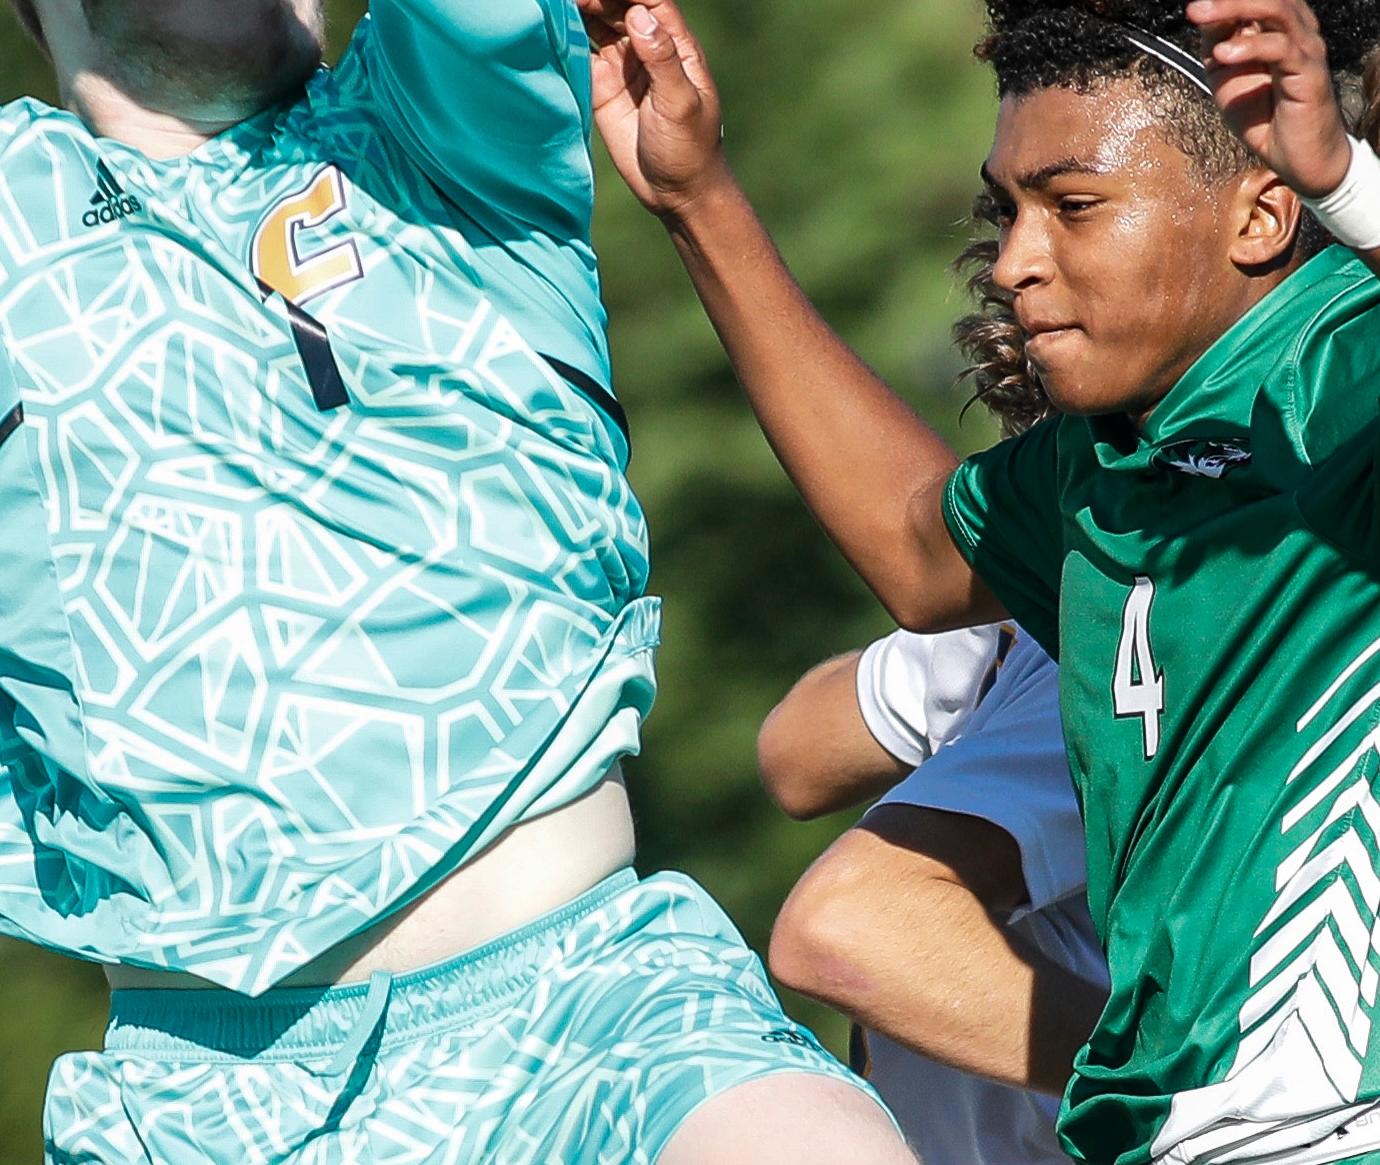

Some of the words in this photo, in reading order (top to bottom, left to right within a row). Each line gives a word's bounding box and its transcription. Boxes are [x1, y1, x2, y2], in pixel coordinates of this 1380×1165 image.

[82, 194, 141, 227] addas
[250, 162, 364, 307] C
[1113, 574, 1164, 760] 4
